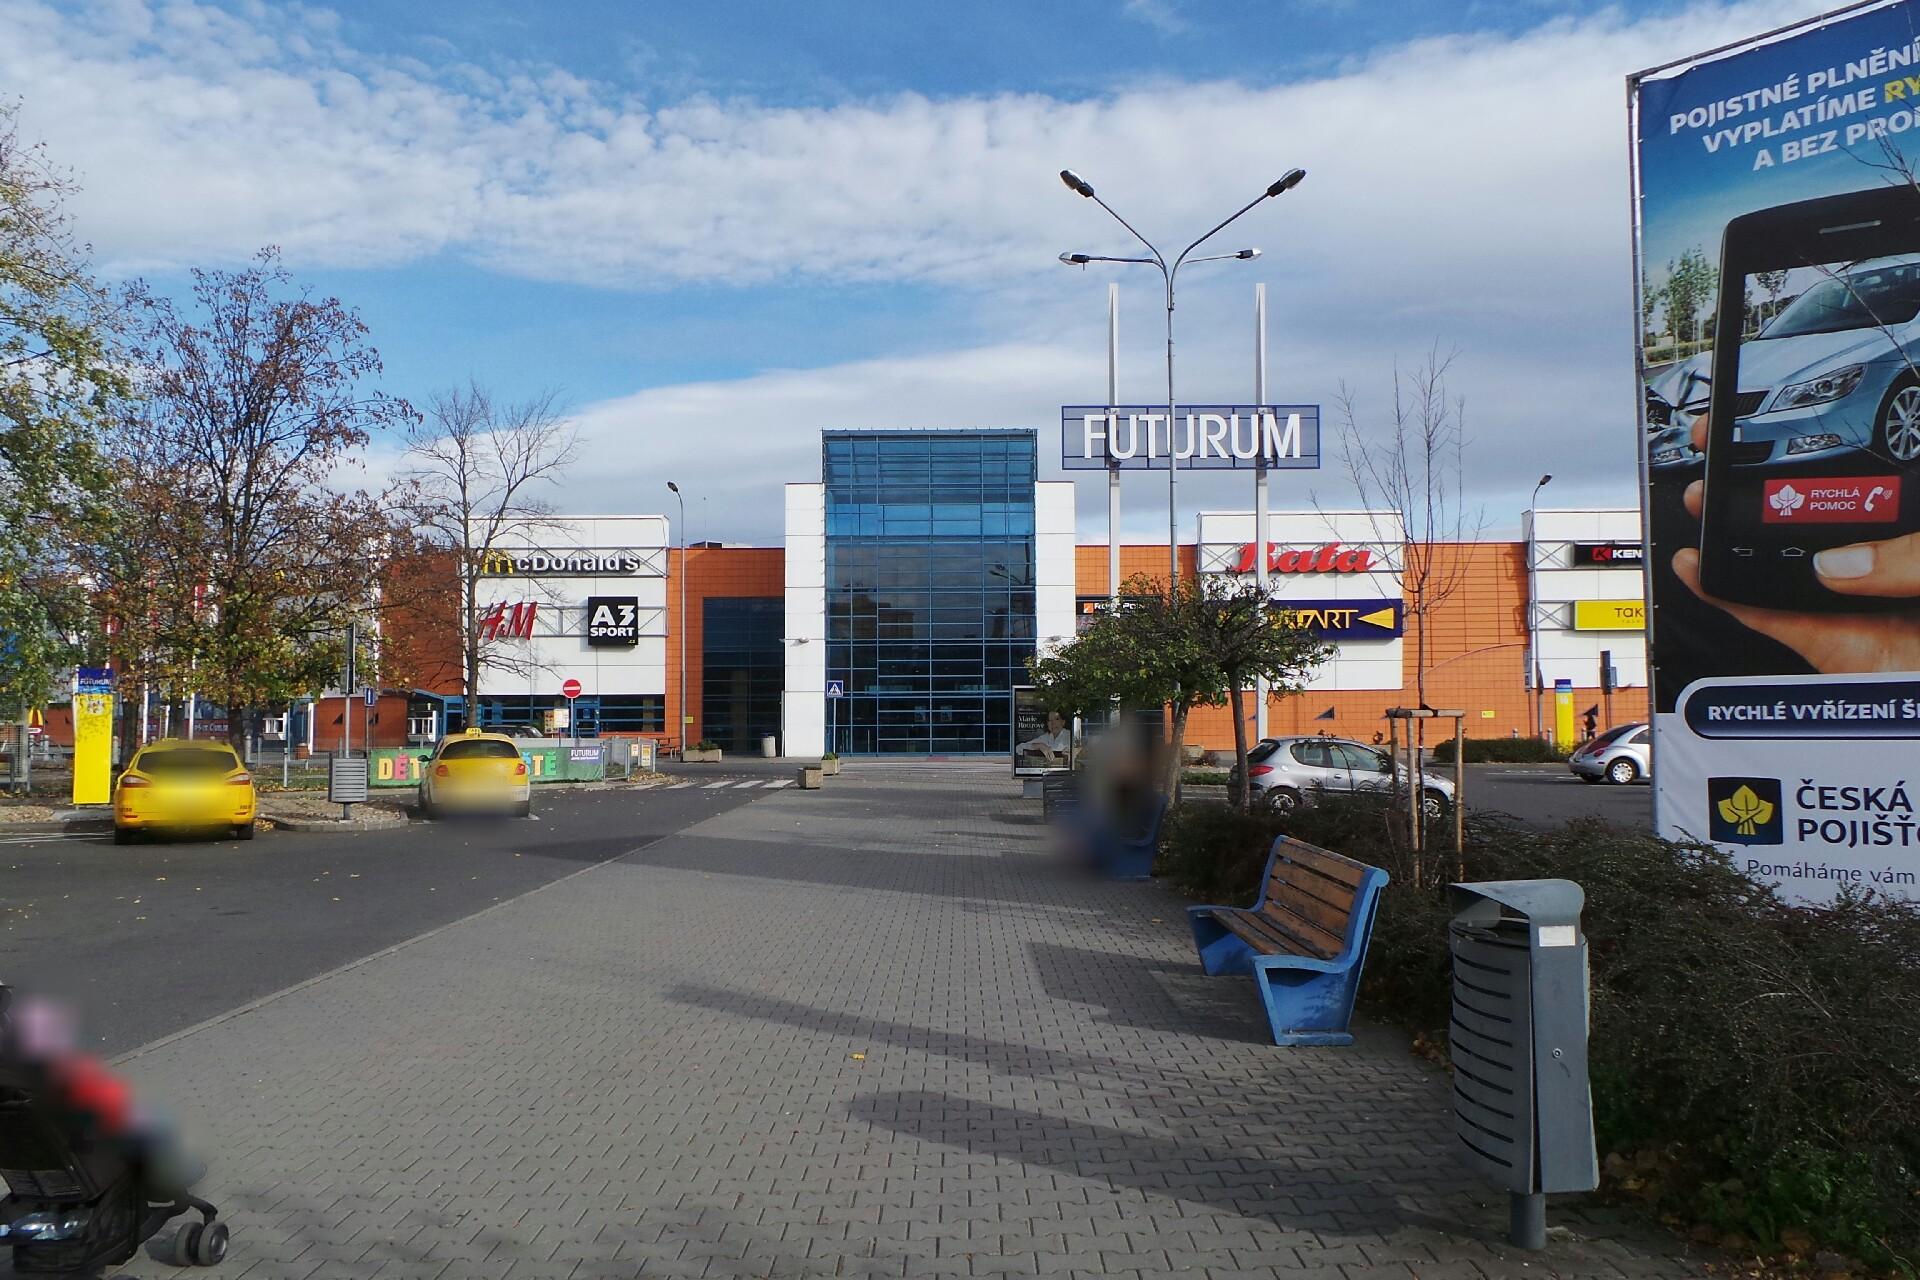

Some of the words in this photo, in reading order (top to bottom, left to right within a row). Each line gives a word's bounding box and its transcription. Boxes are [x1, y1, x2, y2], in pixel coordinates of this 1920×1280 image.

[1670, 73, 1801, 135] POJISTNÉ
[1807, 36, 1920, 94] PLNĚNÍ
[1702, 87, 1877, 153] VYPLATÍME
[1752, 149, 1776, 171] A
[1782, 130, 1839, 164] BEZ
[1083, 413, 1300, 460] FUTURUM
[1810, 487, 1861, 499] RYCHLÁ
[1810, 501, 1856, 511] POMOC
[482, 549, 640, 575] McDonald's
[1232, 541, 1377, 573] Bata
[590, 627, 635, 637] SPORT
[1708, 701, 1787, 720] RYCHLÉ
[1792, 699, 1896, 719] VYŘÍZENÍ
[571, 749, 599, 757] FUTURUM
[1796, 778, 1914, 813] ČESKÁ
[1798, 814, 1920, 848] POJIŠŤ
[1747, 859, 1862, 882] Pomáháme
[1869, 866, 1915, 885] vám
